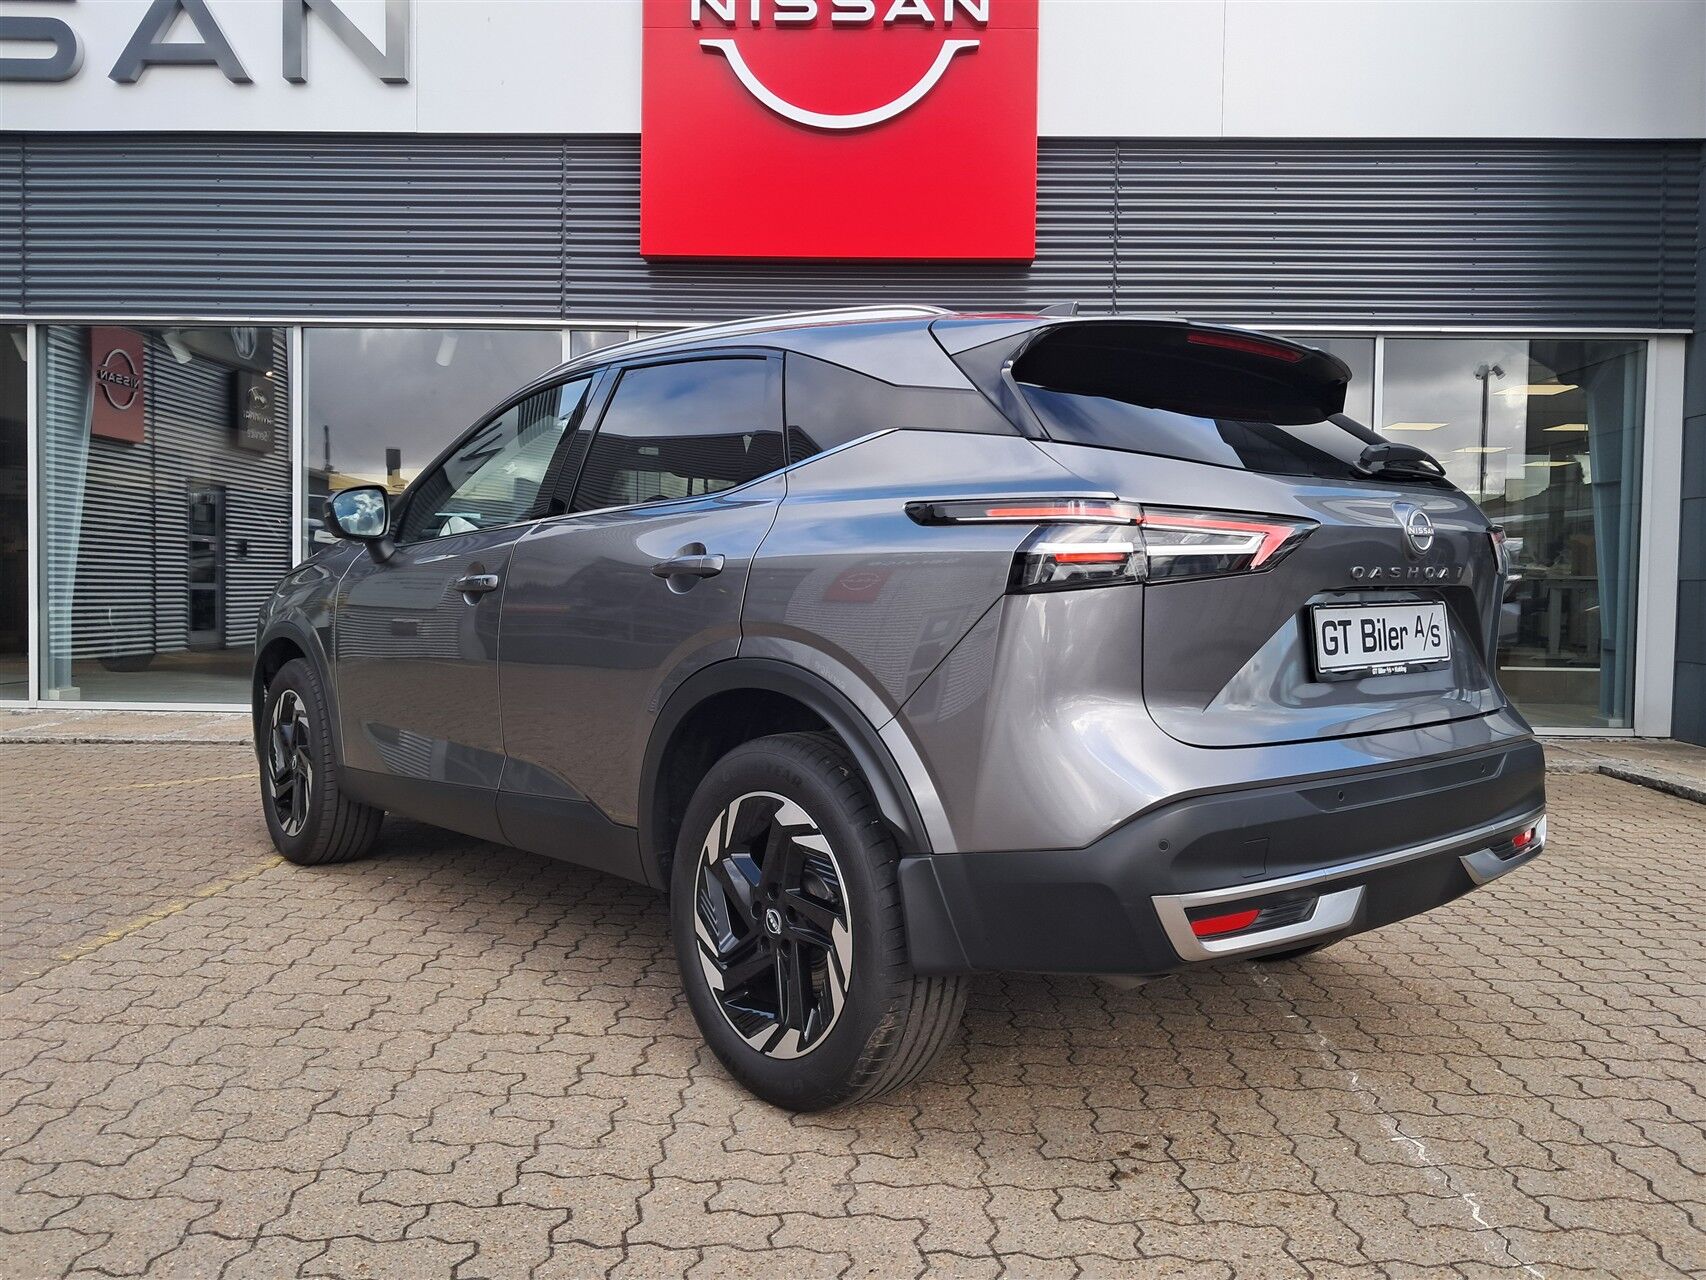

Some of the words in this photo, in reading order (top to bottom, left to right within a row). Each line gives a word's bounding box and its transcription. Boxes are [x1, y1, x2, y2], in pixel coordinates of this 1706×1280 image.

[690, 0, 989, 25] NISSAN
[1407, 526, 1435, 535] NISSAN
[1350, 566, 1463, 579] QASHQAI
[1321, 620, 1352, 656] GT
[1360, 618, 1408, 653] Biler
